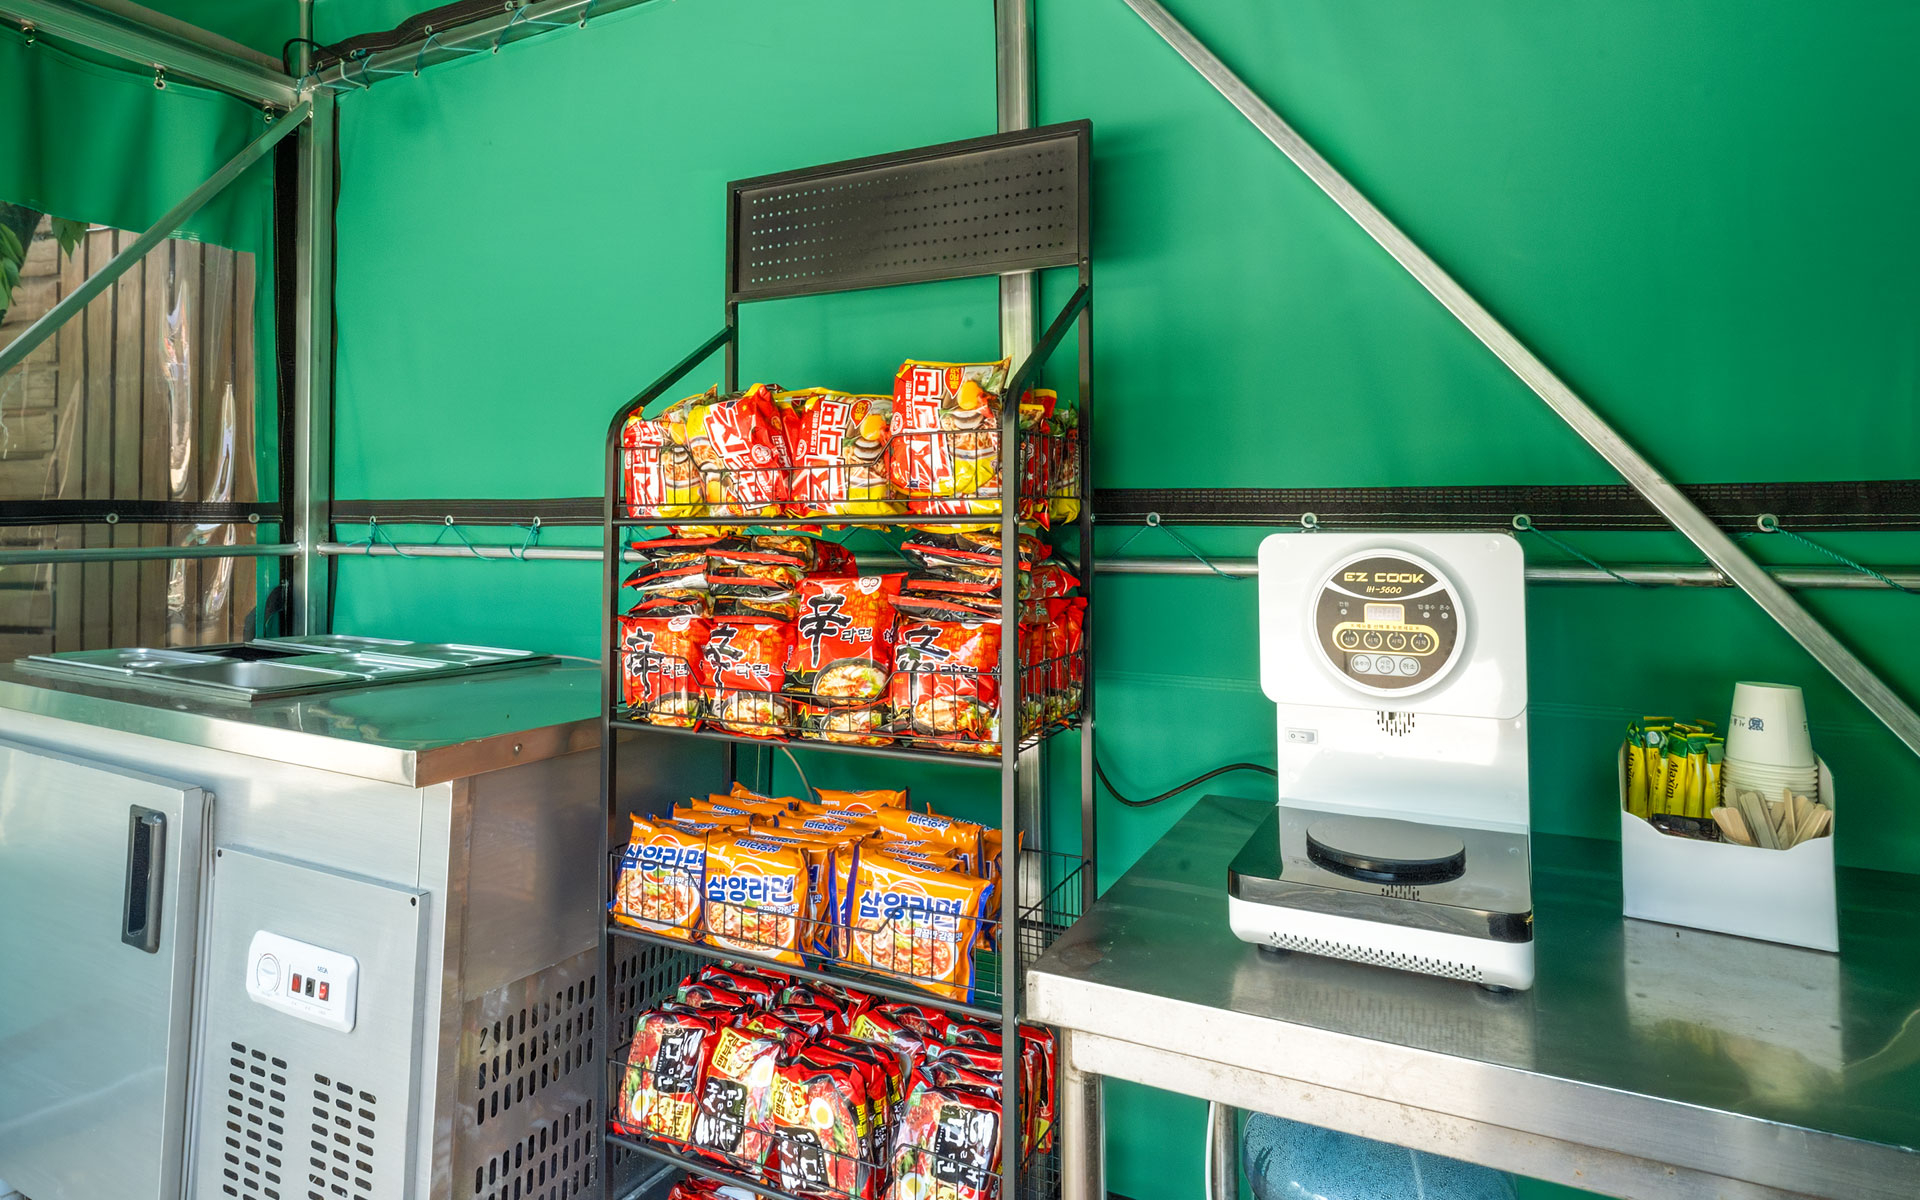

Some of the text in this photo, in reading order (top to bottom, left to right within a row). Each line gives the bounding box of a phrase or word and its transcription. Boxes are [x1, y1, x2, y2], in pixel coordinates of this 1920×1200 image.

[903, 368, 953, 489] 진라면
[632, 421, 665, 504] 진라면
[704, 408, 773, 511] 진라면
[803, 400, 851, 504] 진라면
[1344, 571, 1425, 584] EZ COOK
[1366, 585, 1402, 595] IH-5600
[798, 588, 853, 669] 辛
[841, 627, 874, 643] 라면
[661, 663, 690, 678] 라면
[735, 662, 770, 680] 라면
[940, 664, 978, 680] 라면
[1401, 662, 1416, 670] 취소
[1666, 761, 1680, 799] Maxim
[621, 844, 706, 877] 삼양라면
[706, 873, 797, 905] 삼양라면
[859, 888, 963, 929] 삼양라면
